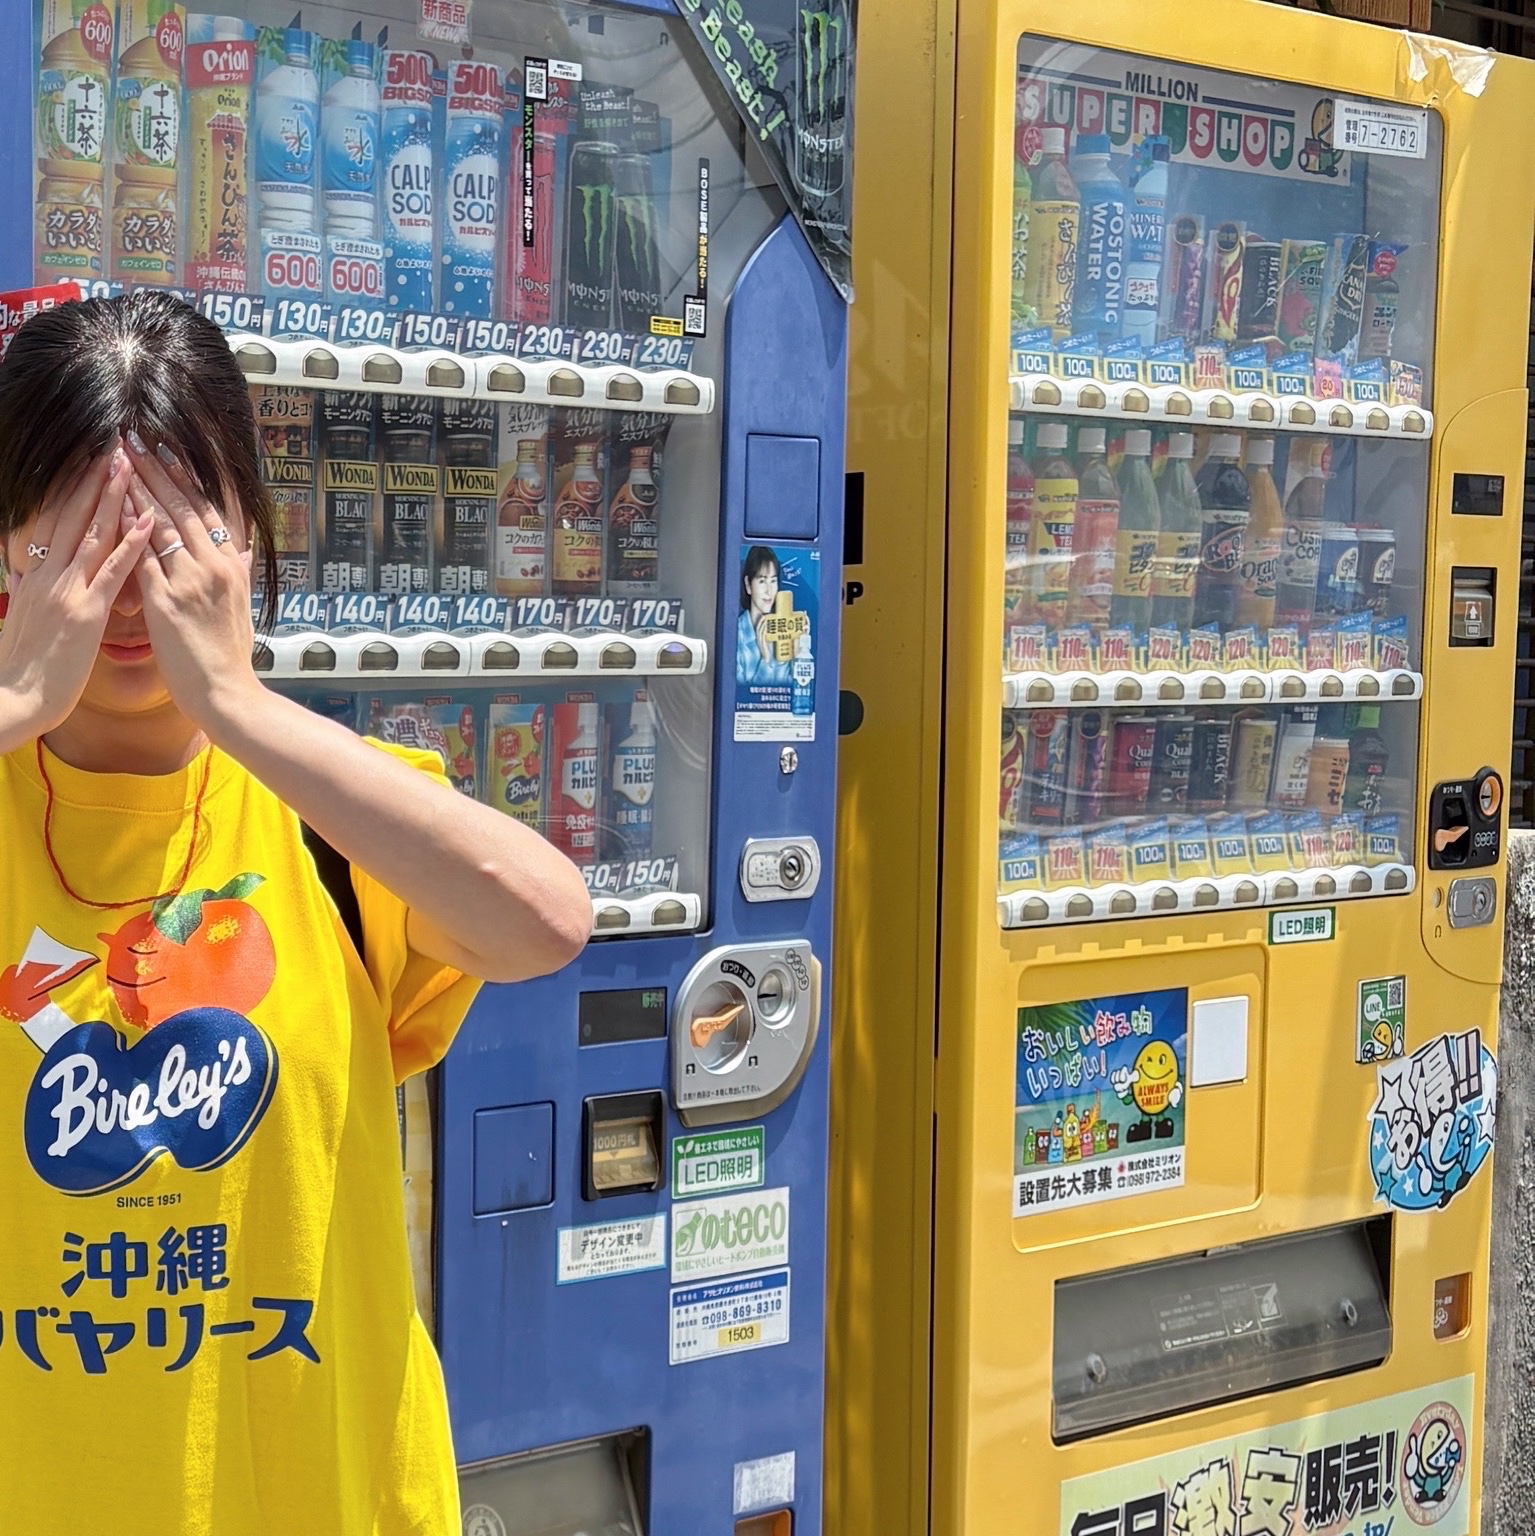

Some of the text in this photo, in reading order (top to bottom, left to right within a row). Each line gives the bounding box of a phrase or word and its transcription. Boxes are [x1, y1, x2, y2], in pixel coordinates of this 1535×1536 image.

[422, 0, 466, 26] 新商品
[85, 20, 111, 42] 600
[160, 28, 182, 51] 600
[202, 43, 249, 72] Orion
[386, 53, 432, 85] 500
[700, 9, 786, 141] Beast!
[1125, 71, 1199, 103] MILLION
[580, 89, 616, 103] Unleash
[584, 96, 631, 112] the Beast!
[75, 76, 98, 155] 十六茶
[150, 83, 172, 161] 十六茶
[1022, 84, 1292, 158] SUPER SHOP
[1361, 124, 1416, 148] 7-2762
[1086, 202, 1109, 281] WATER
[266, 253, 320, 289] 600
[1104, 201, 1124, 324] POSTONIC
[331, 260, 378, 296] 600
[202, 293, 261, 328] 150円
[277, 300, 328, 333] 130円
[340, 307, 392, 340] 130円
[404, 313, 455, 346] 150円
[466, 320, 515, 350] 150円
[522, 325, 571, 356] 230円
[581, 330, 631, 360] 230円
[639, 336, 689, 365] 230円
[1020, 354, 1048, 373] 100円
[1066, 358, 1093, 377] 100円
[1110, 363, 1137, 380] 100円
[1153, 366, 1179, 382] 100円
[1237, 371, 1261, 387] 100円
[1279, 377, 1304, 393] 100円
[1357, 385, 1379, 400] 100円
[329, 462, 374, 485] WONDA
[389, 465, 435, 487] WONDA
[450, 468, 495, 491] WONDA
[1009, 534, 1026, 544] TEA
[277, 594, 325, 622] 140円
[335, 594, 385, 623] 140円
[398, 595, 447, 624] 140円
[456, 596, 504, 624] 140円
[517, 598, 563, 625] 170円
[576, 599, 621, 625] 170円
[632, 600, 677, 626] 170円
[1219, 841, 1244, 857] 100円
[1258, 838, 1282, 853] 100円
[582, 863, 617, 887] 50円
[625, 858, 671, 886] 150円
[1008, 863, 1035, 880] 100円
[1278, 916, 1326, 937] LED照明
[1365, 1003, 1381, 1014] LINE
[1022, 1004, 1153, 1063] おいしい飲み物
[1026, 1050, 1108, 1099] いっぱい!
[41, 1035, 252, 1158] Bireley's
[1138, 1082, 1170, 1098] ALWAYS
[1141, 1096, 1166, 1108] SMILE
[593, 1133, 636, 1150] 1000円札
[685, 1155, 753, 1186] LED照明
[1127, 1155, 1182, 1172] 株式会社ミリオン
[1019, 1166, 1113, 1207] 設置先大募集
[116, 1192, 183, 1209] SINCE 1951
[581, 1233, 643, 1253] デザイン変更中
[61, 1223, 230, 1299] 沖縄
[710, 1298, 782, 1324] 098-869-8310
[728, 1326, 755, 1343] 1503
